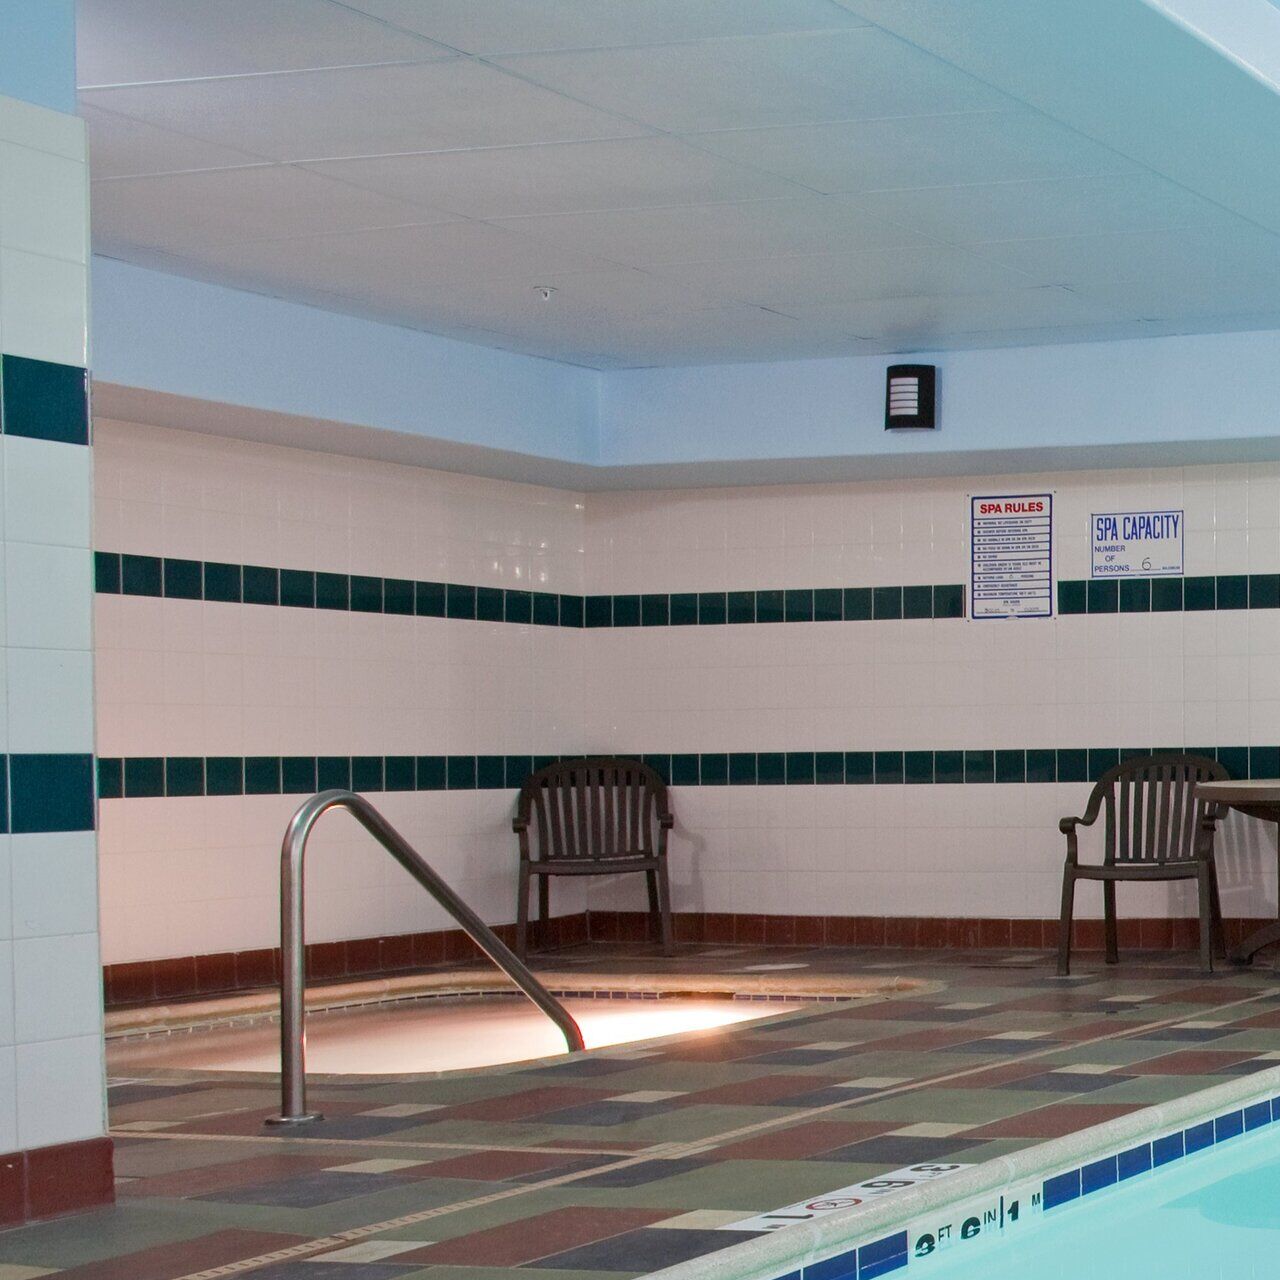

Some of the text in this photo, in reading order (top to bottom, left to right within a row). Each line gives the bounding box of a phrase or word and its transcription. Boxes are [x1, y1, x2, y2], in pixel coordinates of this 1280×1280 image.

[980, 501, 1044, 515] SPA RULES
[1096, 515, 1180, 542] SPA CAPACITY
[1094, 544, 1127, 553] NUMBER
[1094, 564, 1130, 573] PERSONS
[1141, 556, 1152, 571] 6
[1104, 554, 1117, 563] OF
[938, 1224, 952, 1242] FT
[984, 1208, 997, 1226] IN
[1032, 1192, 1041, 1207] M
